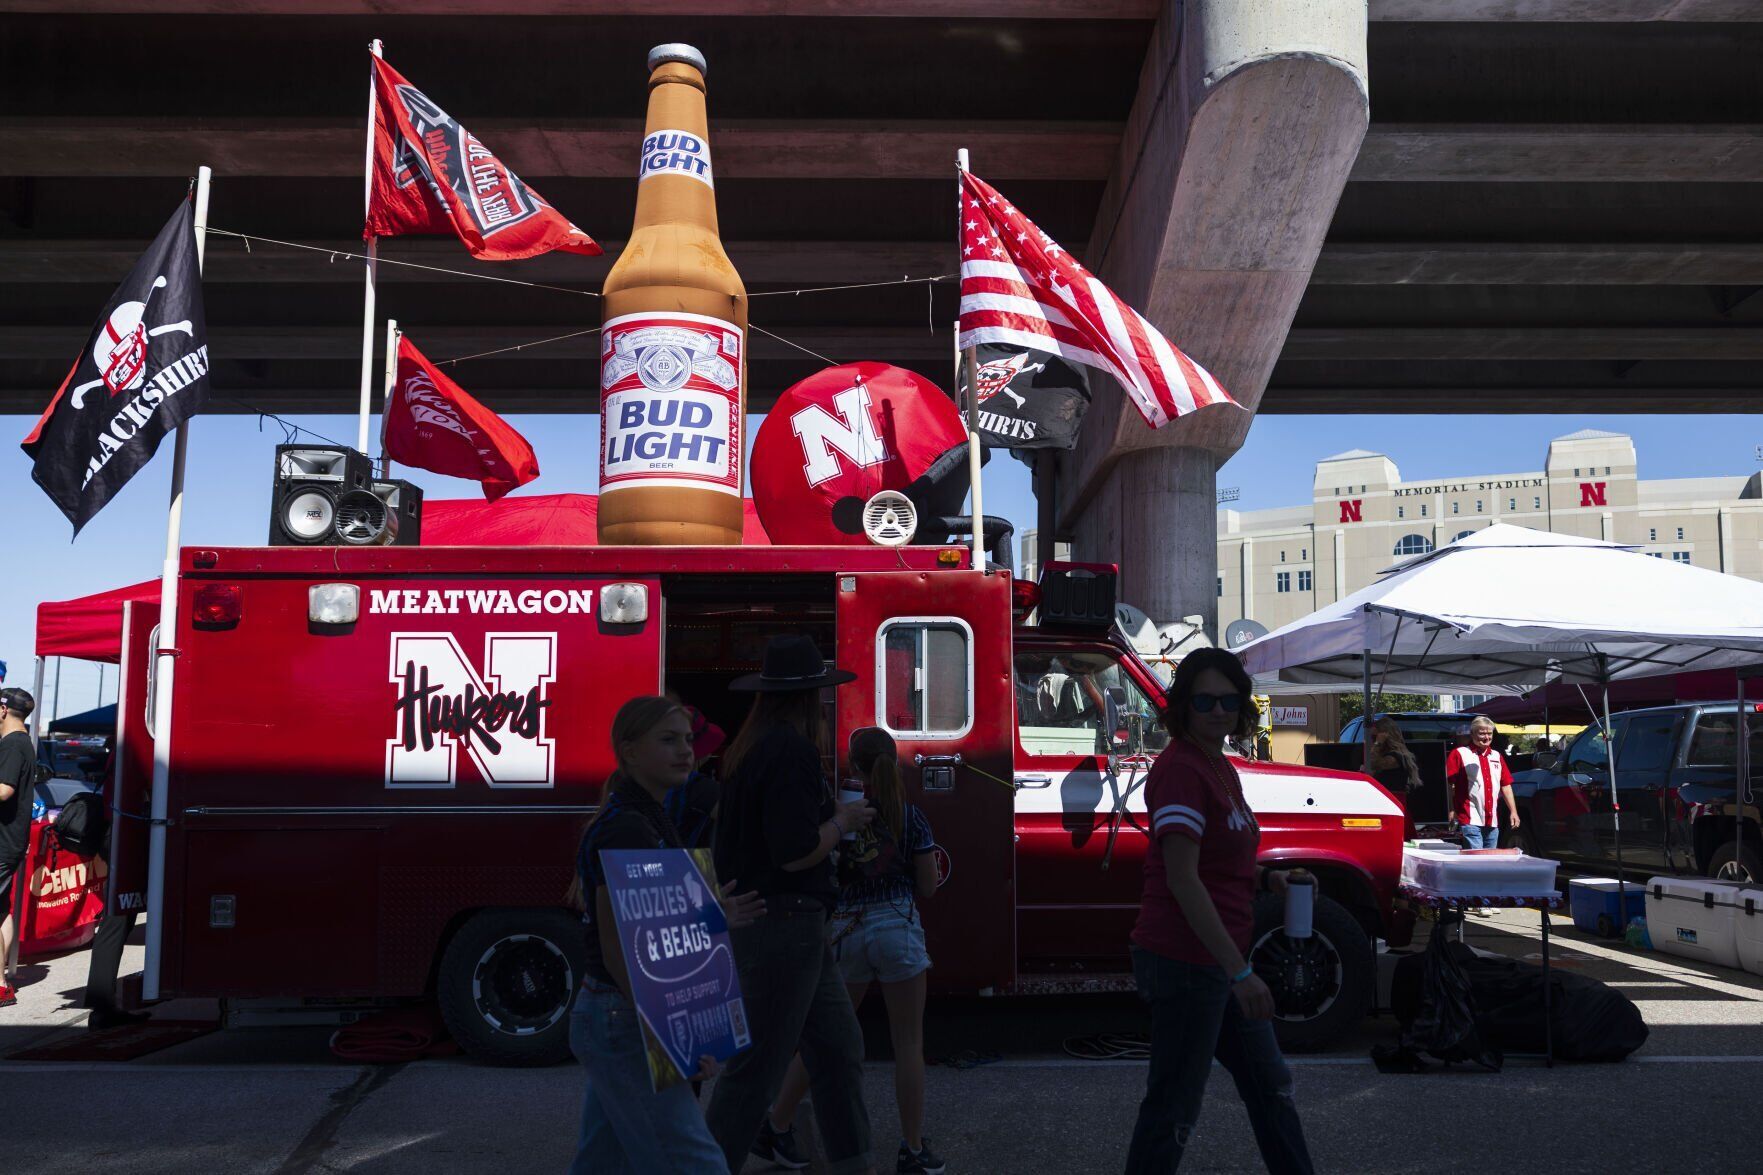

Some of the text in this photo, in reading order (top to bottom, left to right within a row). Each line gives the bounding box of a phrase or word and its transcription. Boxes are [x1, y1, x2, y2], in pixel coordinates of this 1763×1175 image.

[643, 134, 701, 157] BUD
[641, 153, 708, 175] IGHT
[619, 400, 713, 429] BUD
[607, 432, 726, 465] LIGHT
[790, 384, 890, 488] N
[1394, 479, 1543, 497] MEMORIAL STADIUM
[1580, 482, 1607, 507] N
[1339, 500, 1363, 523] N
[394, 659, 552, 756] Huskers
[1280, 708, 1307, 721] Johns
[626, 863, 664, 878] GET YOUR
[616, 885, 688, 922] KOOZIES
[646, 922, 712, 962] & BEADS
[674, 987, 692, 1004] HELP
[692, 979, 720, 999] SUPPORT
